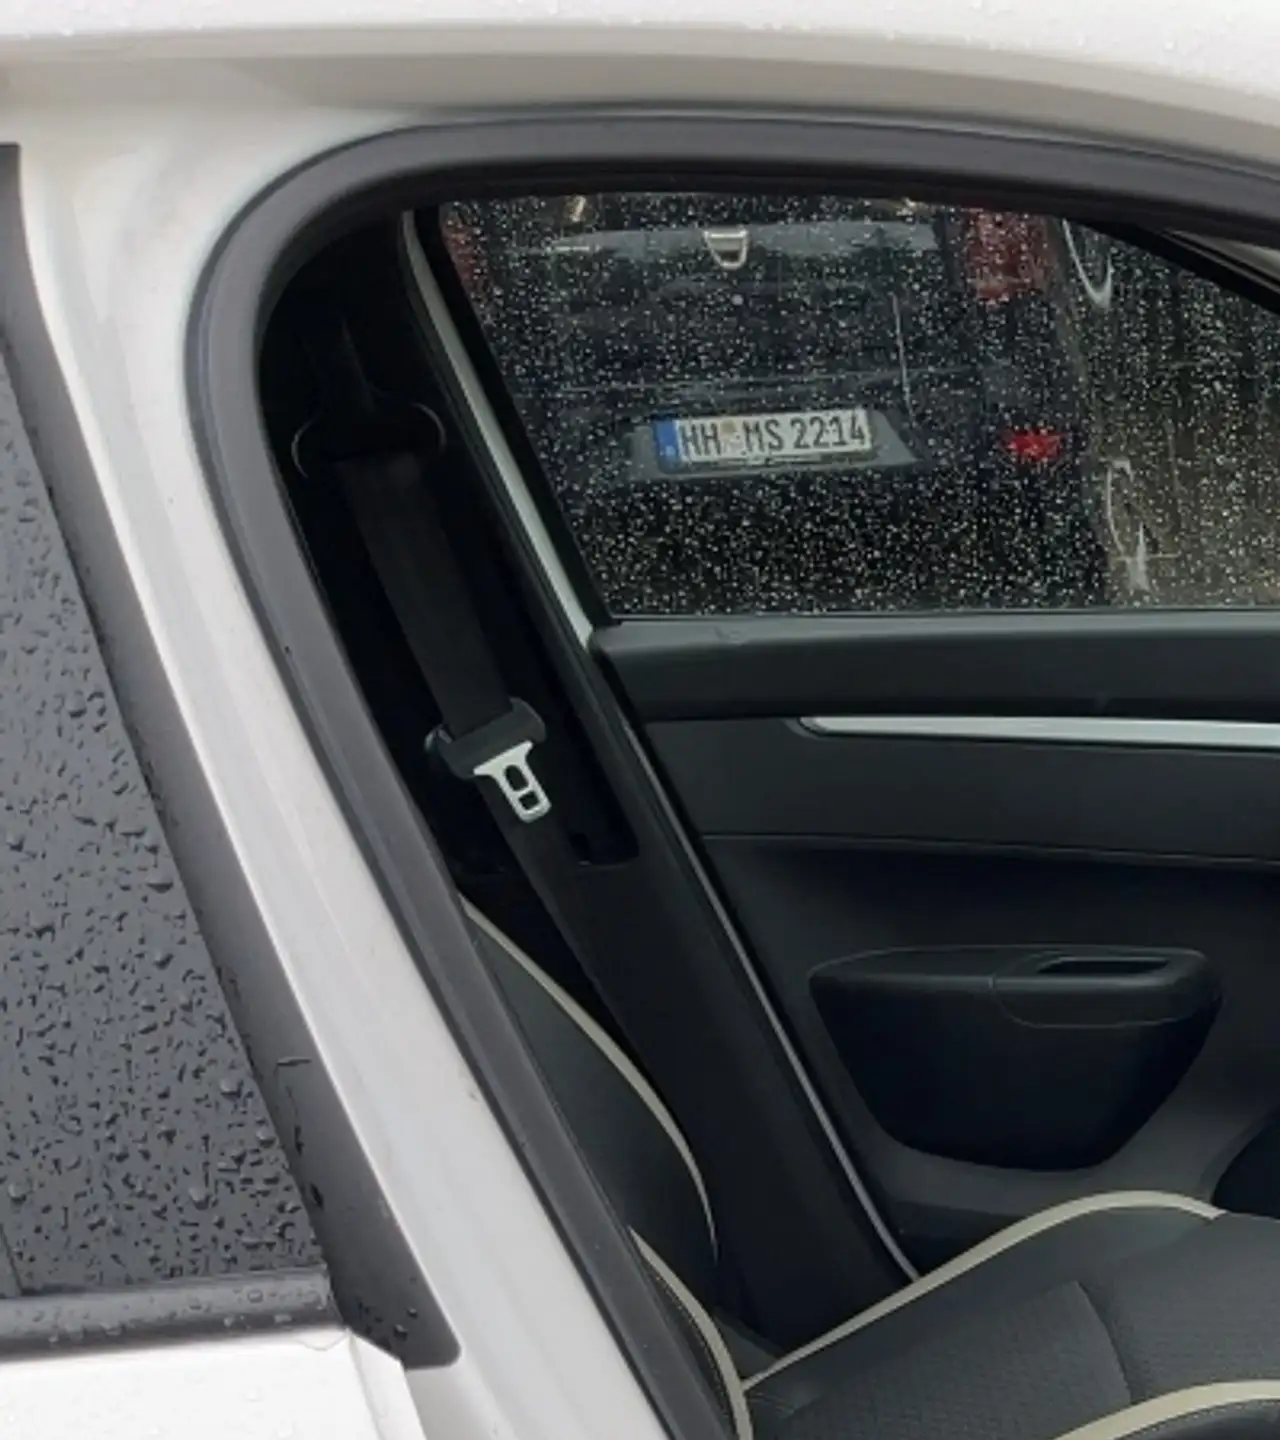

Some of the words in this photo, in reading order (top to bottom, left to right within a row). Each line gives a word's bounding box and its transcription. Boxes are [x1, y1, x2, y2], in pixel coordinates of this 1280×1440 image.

[679, 423, 721, 456] HH
[741, 418, 783, 453] MS
[790, 414, 865, 448] 2214
